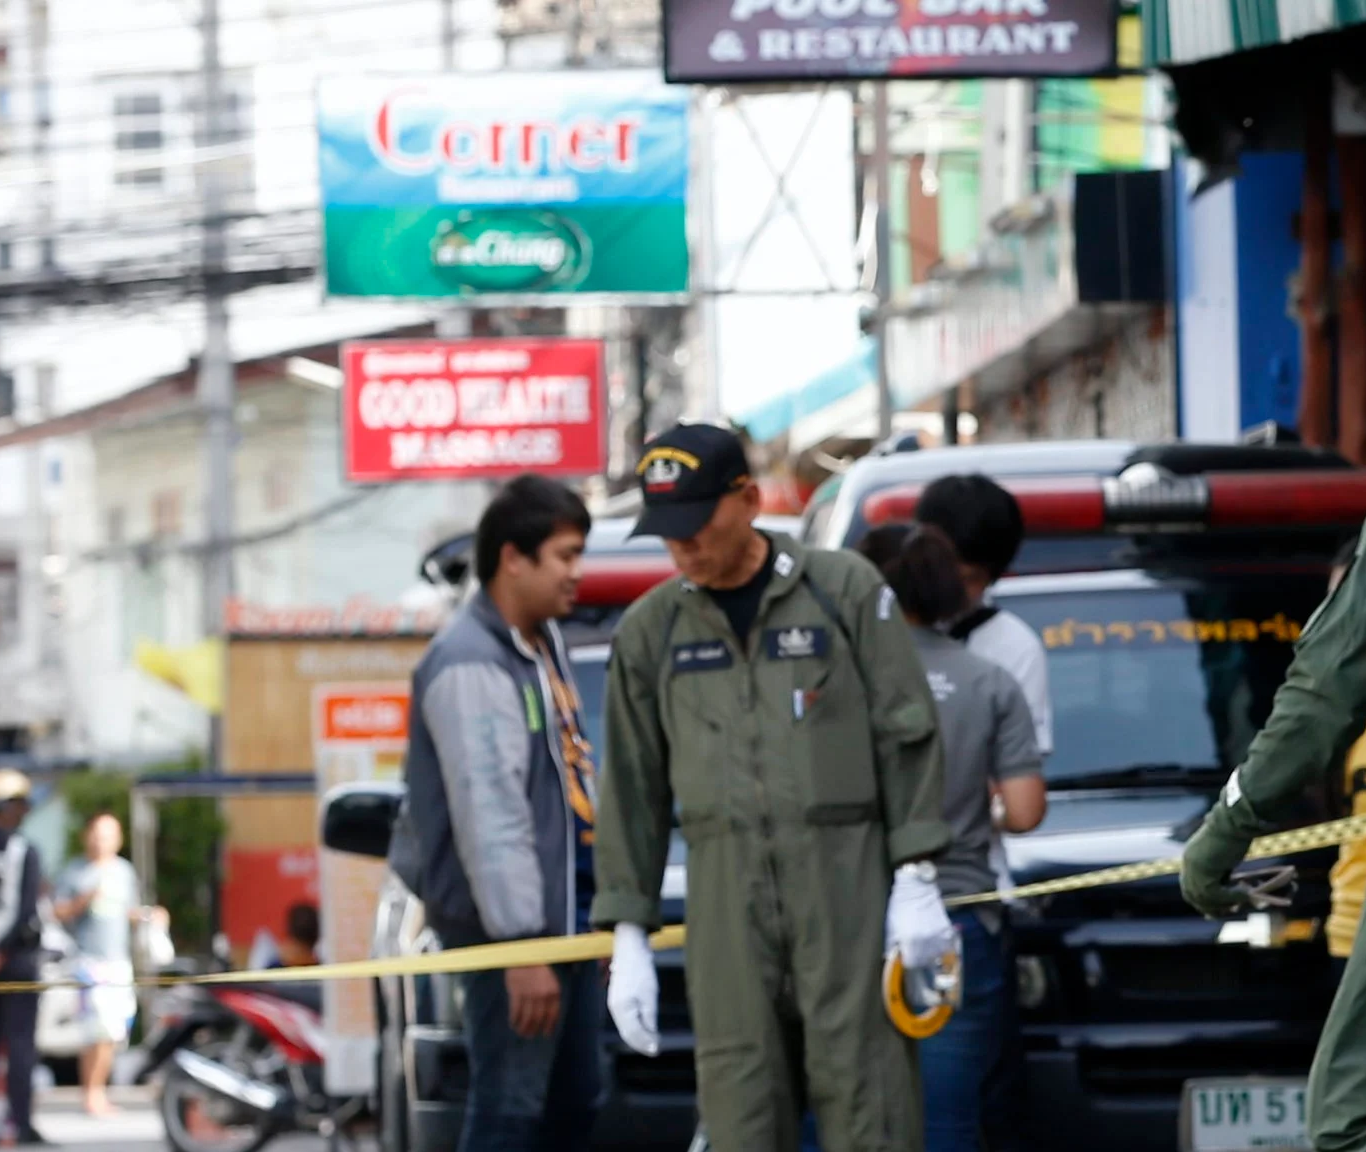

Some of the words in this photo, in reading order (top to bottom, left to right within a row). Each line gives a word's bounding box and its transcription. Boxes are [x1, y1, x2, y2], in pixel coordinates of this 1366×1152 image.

[708, 30, 747, 62] &
[758, 22, 1079, 61] RESTAURANT
[372, 84, 639, 170] Corner
[358, 379, 457, 429] GOOD
[389, 429, 564, 469] MASSAGE
